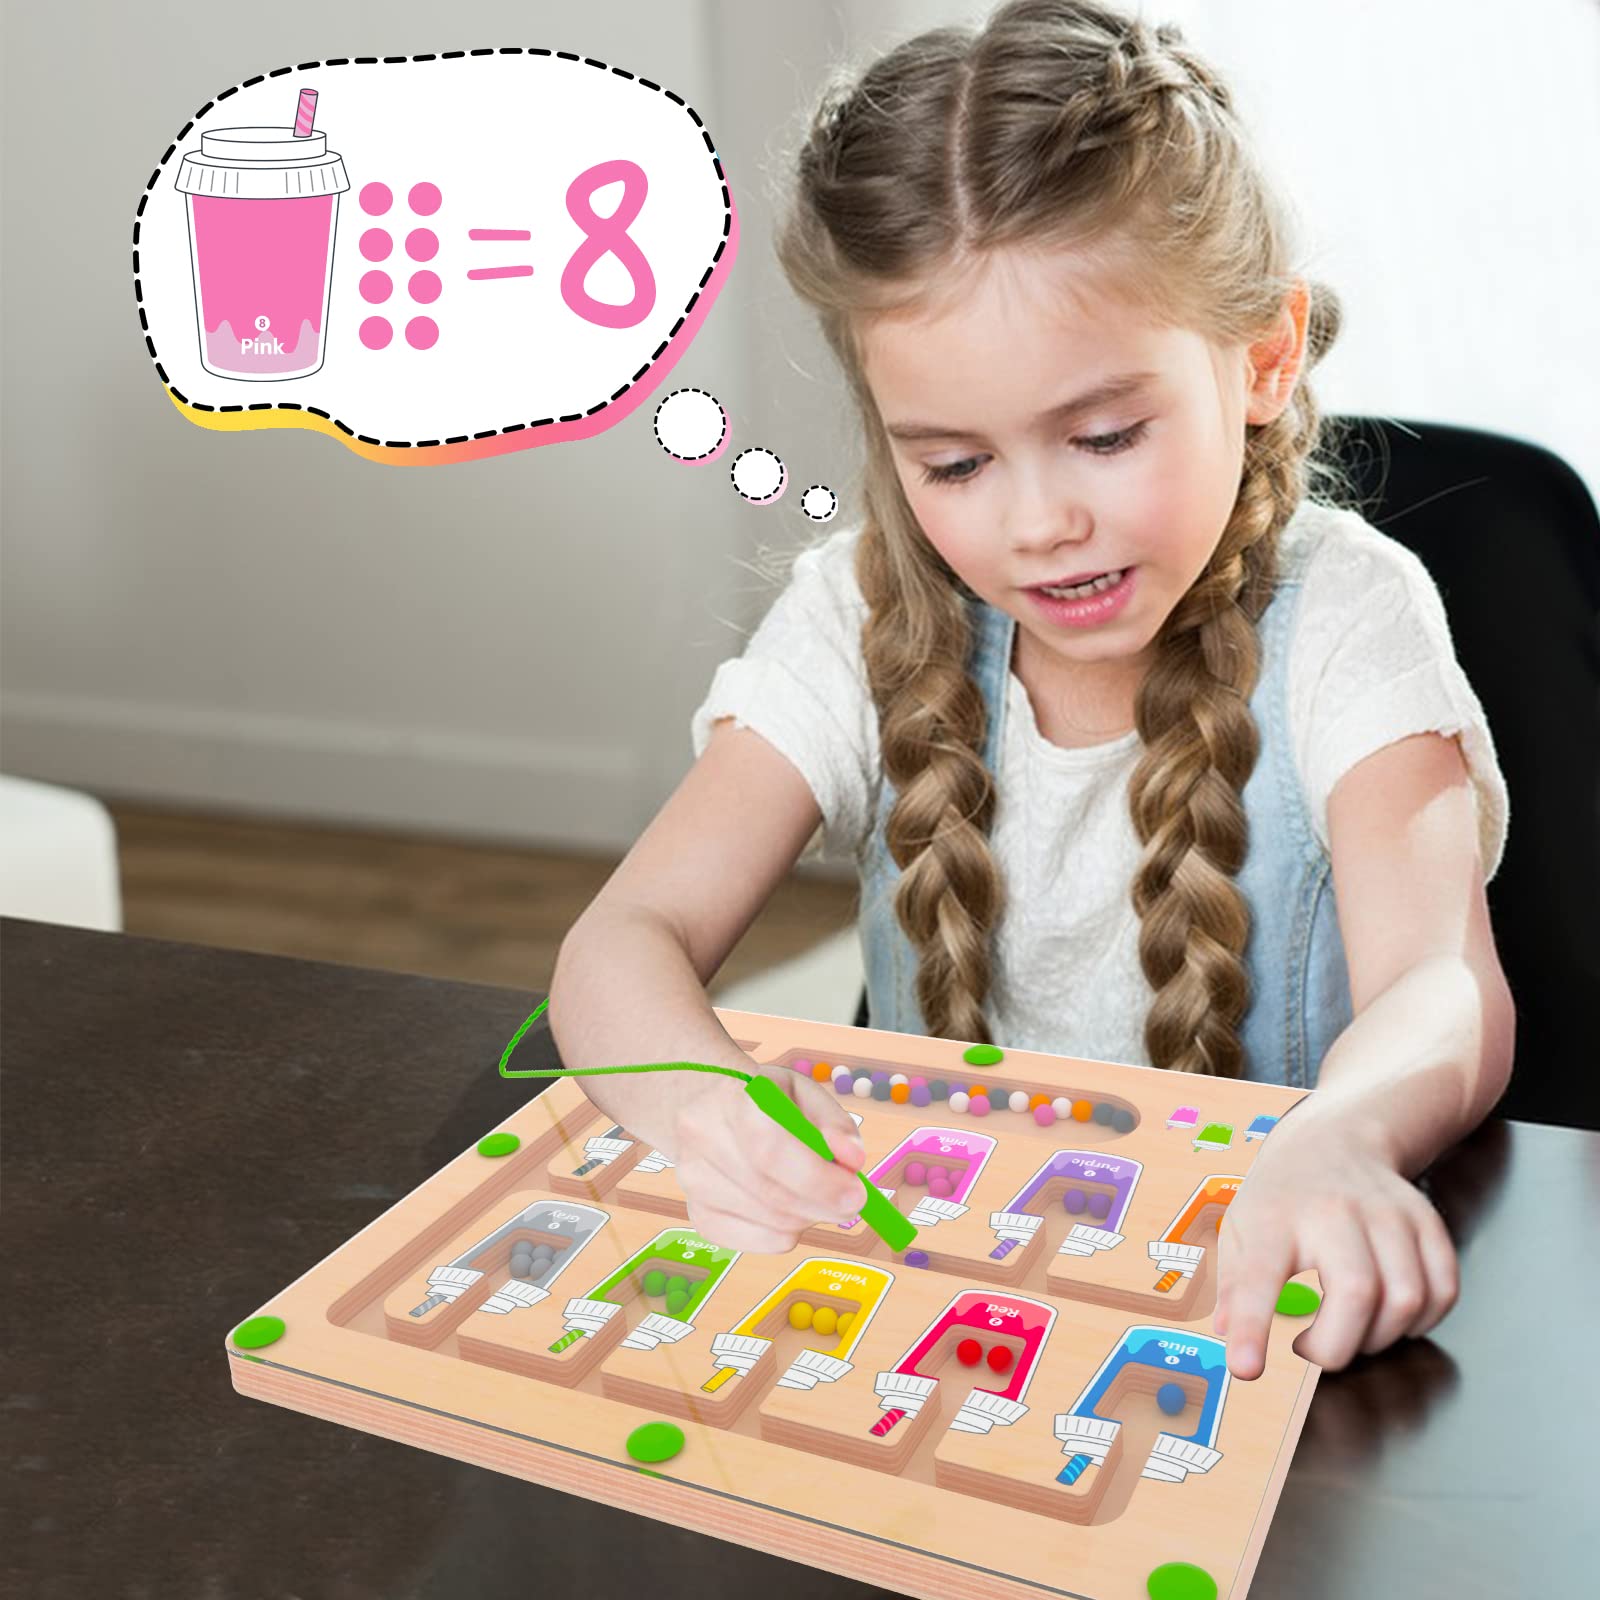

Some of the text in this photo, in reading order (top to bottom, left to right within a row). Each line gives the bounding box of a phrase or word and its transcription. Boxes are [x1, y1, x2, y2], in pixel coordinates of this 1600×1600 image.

[937, 1135, 968, 1147] Pink
[1071, 1158, 1120, 1172] Purple
[547, 1210, 580, 1222] Gray
[677, 1238, 719, 1253] Green
[818, 1268, 867, 1286] Yellow
[985, 1304, 1020, 1318] Red
[1158, 1340, 1199, 1357] Blue
